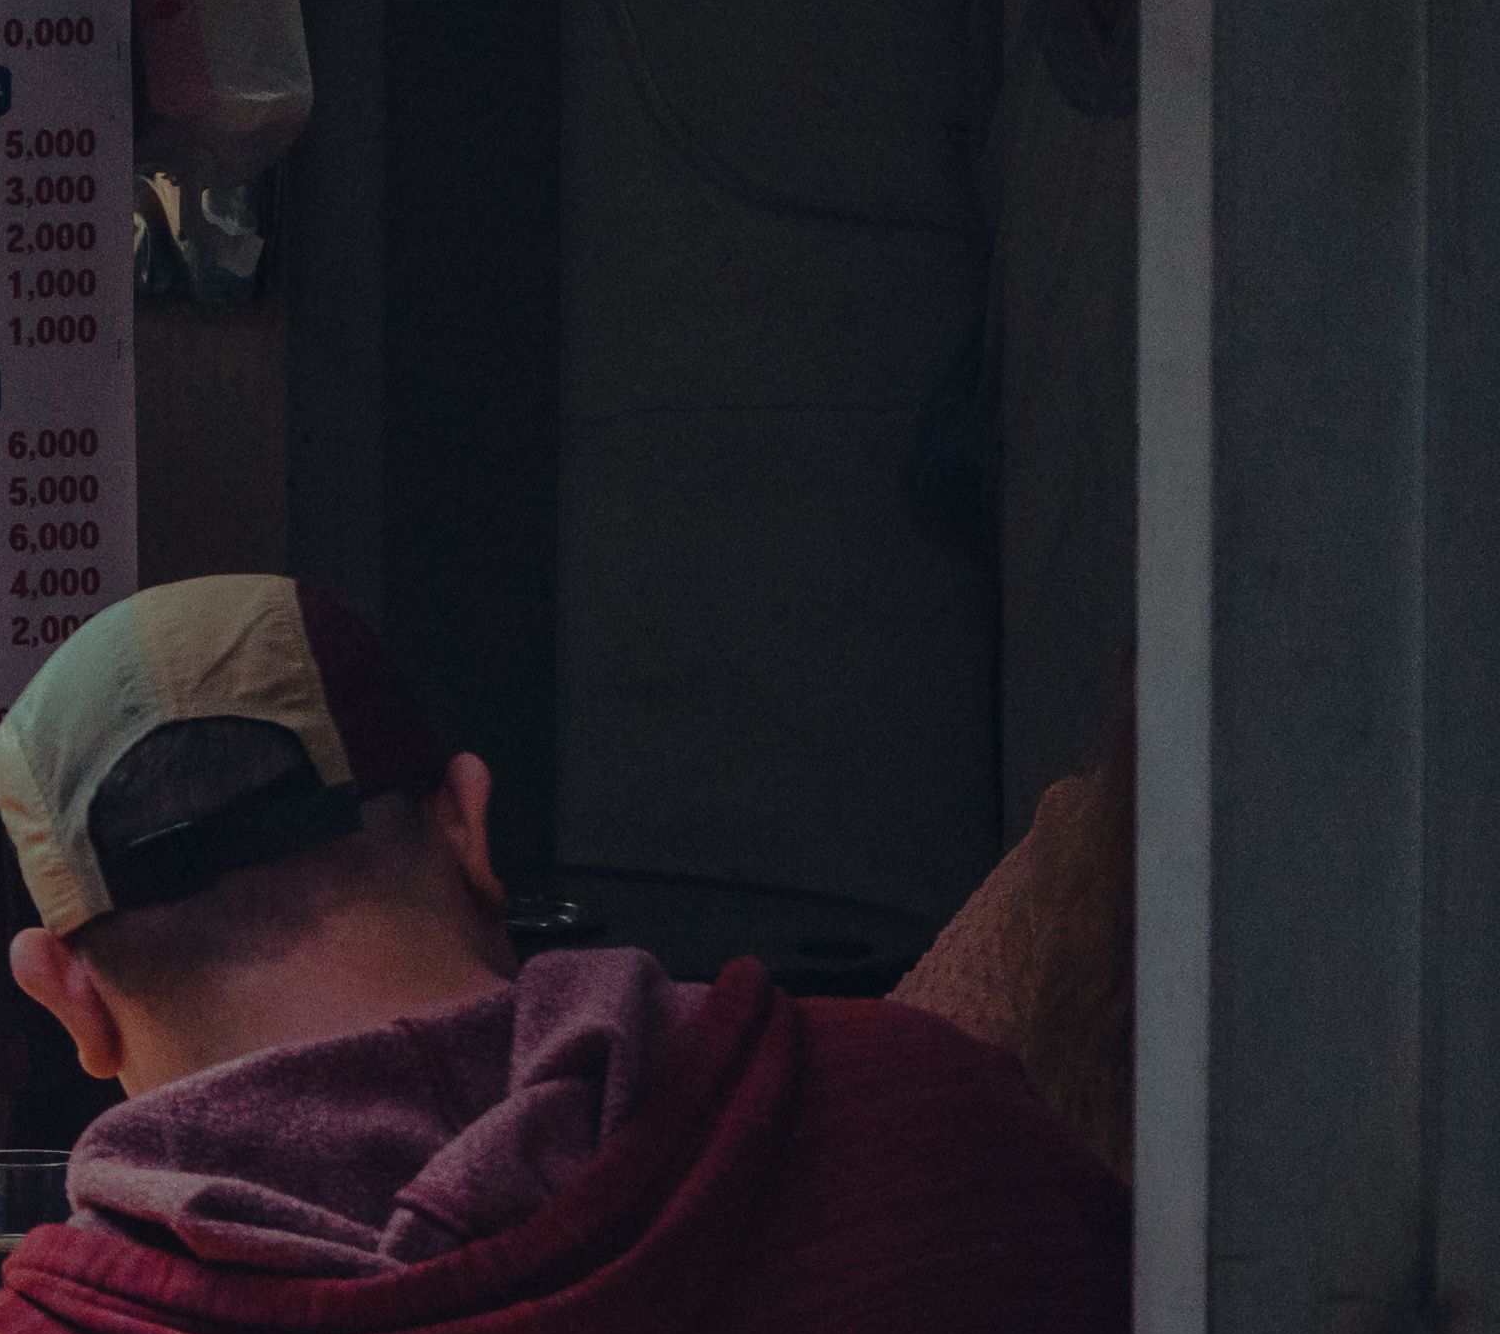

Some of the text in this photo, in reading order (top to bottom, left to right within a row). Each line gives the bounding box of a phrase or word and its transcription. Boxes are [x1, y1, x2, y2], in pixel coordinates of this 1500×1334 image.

[6, 129, 96, 160] 5,000
[6, 175, 96, 207] 3,000
[7, 222, 96, 254] 2,000
[9, 269, 96, 301] 1,000
[10, 315, 97, 347] 1,000
[8, 428, 98, 460] 6,000
[10, 475, 99, 507] 5,000
[9, 521, 99, 553] 6,000
[10, 567, 100, 600] 4,000
